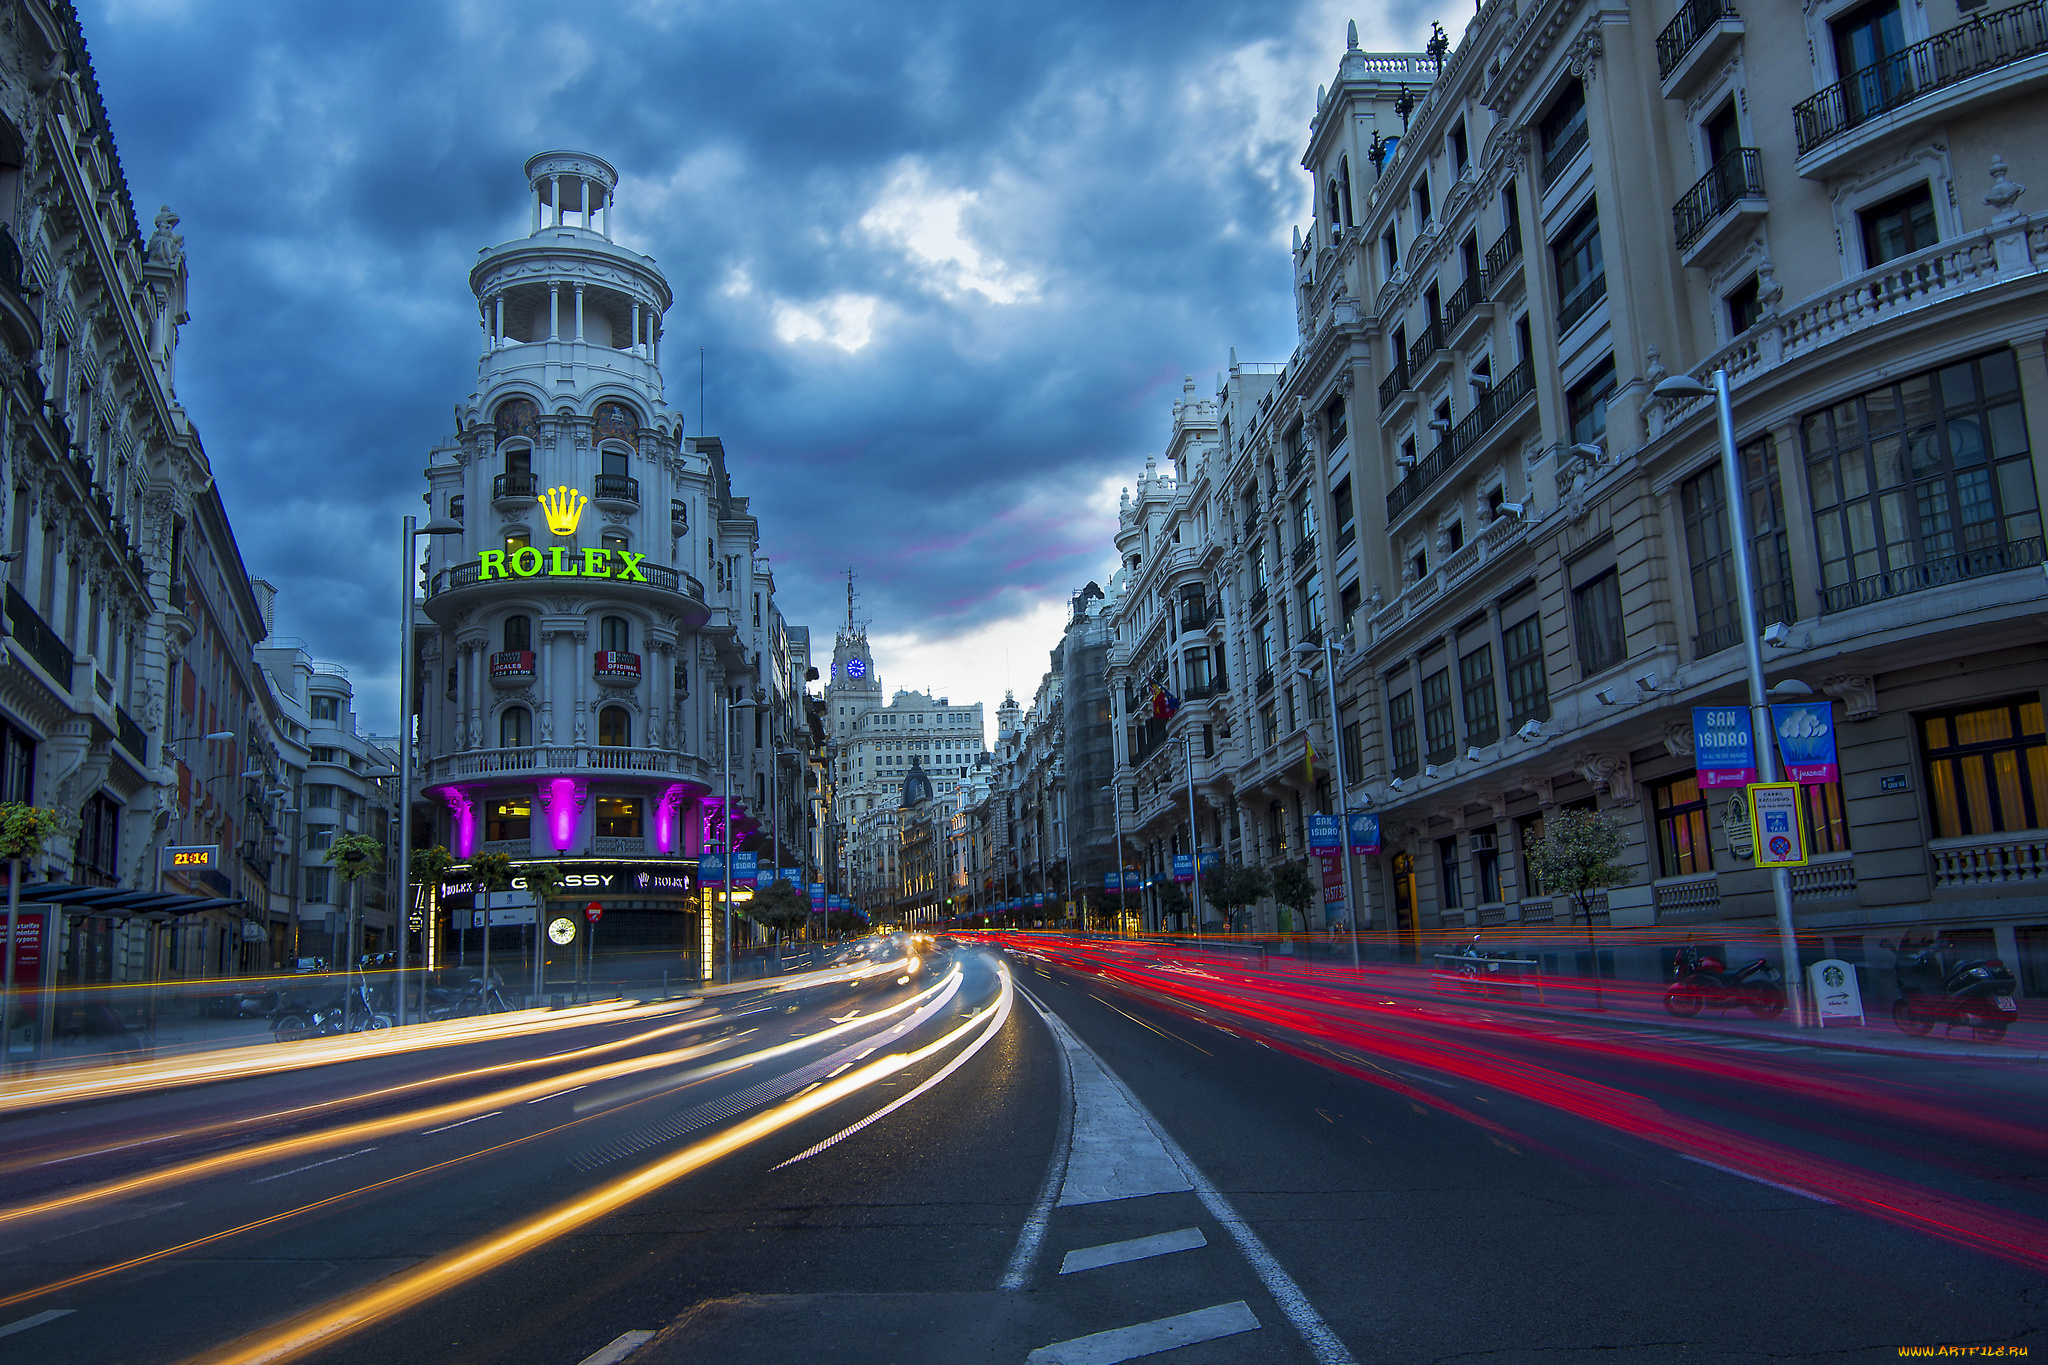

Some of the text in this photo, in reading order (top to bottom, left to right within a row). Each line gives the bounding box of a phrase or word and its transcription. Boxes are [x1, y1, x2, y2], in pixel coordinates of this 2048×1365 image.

[478, 546, 648, 583] ROLEX
[1707, 711, 1736, 727] SAN
[1699, 731, 1748, 748] ISIDRO
[1315, 817, 1332, 826] SAN
[1311, 827, 1338, 836] ISIDRO
[174, 852, 209, 866] 21:14
[737, 853, 752, 861] SAN
[732, 862, 757, 870] ISIDRO
[654, 876, 683, 887] ROLEX
[446, 882, 473, 896] ROLEX
